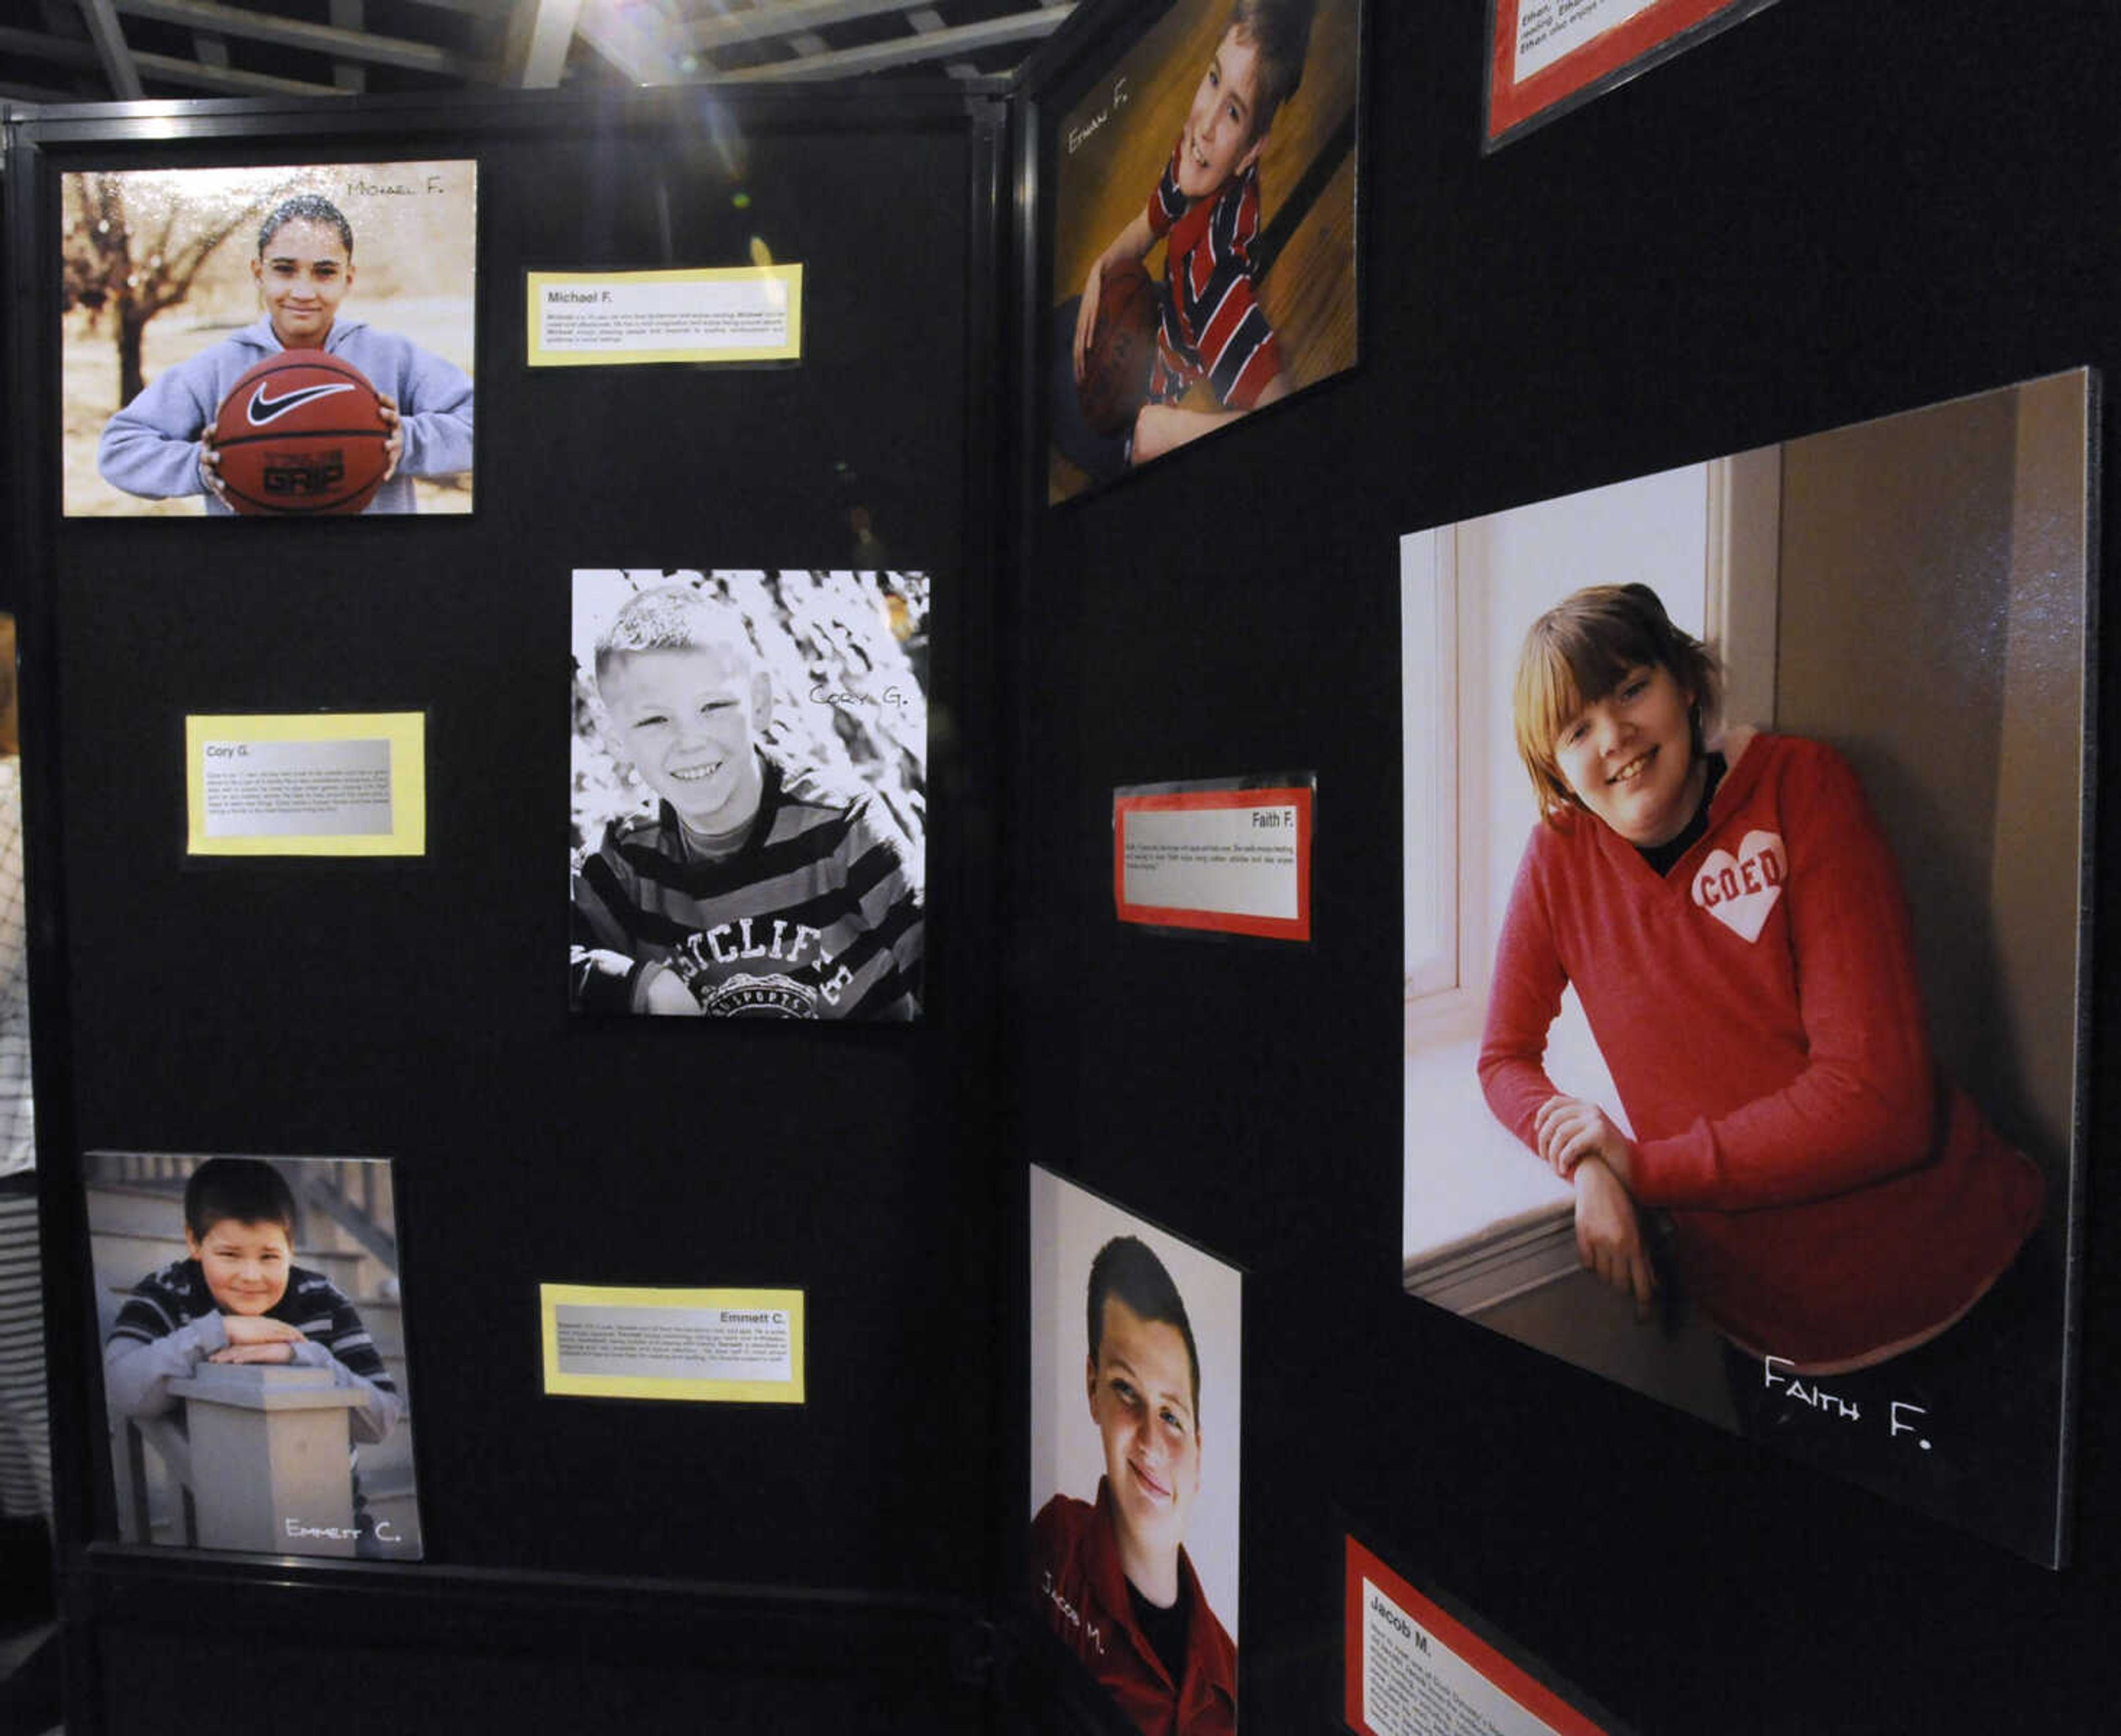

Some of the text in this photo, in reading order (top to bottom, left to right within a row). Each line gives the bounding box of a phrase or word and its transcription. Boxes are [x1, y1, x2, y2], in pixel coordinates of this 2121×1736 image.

[427, 175, 445, 194] F.
[548, 291, 613, 303] Michael F.
[883, 686, 908, 706] G.
[207, 746, 233, 759] Cory
[1252, 811, 1294, 828] Faith F.
[1701, 847, 1780, 907] COED
[720, 1311, 786, 1324] Emmett C.
[1891, 1401, 1932, 1450] F.
[374, 1521, 402, 1542] C.
[1371, 1597, 1432, 1657] Jacob M.
